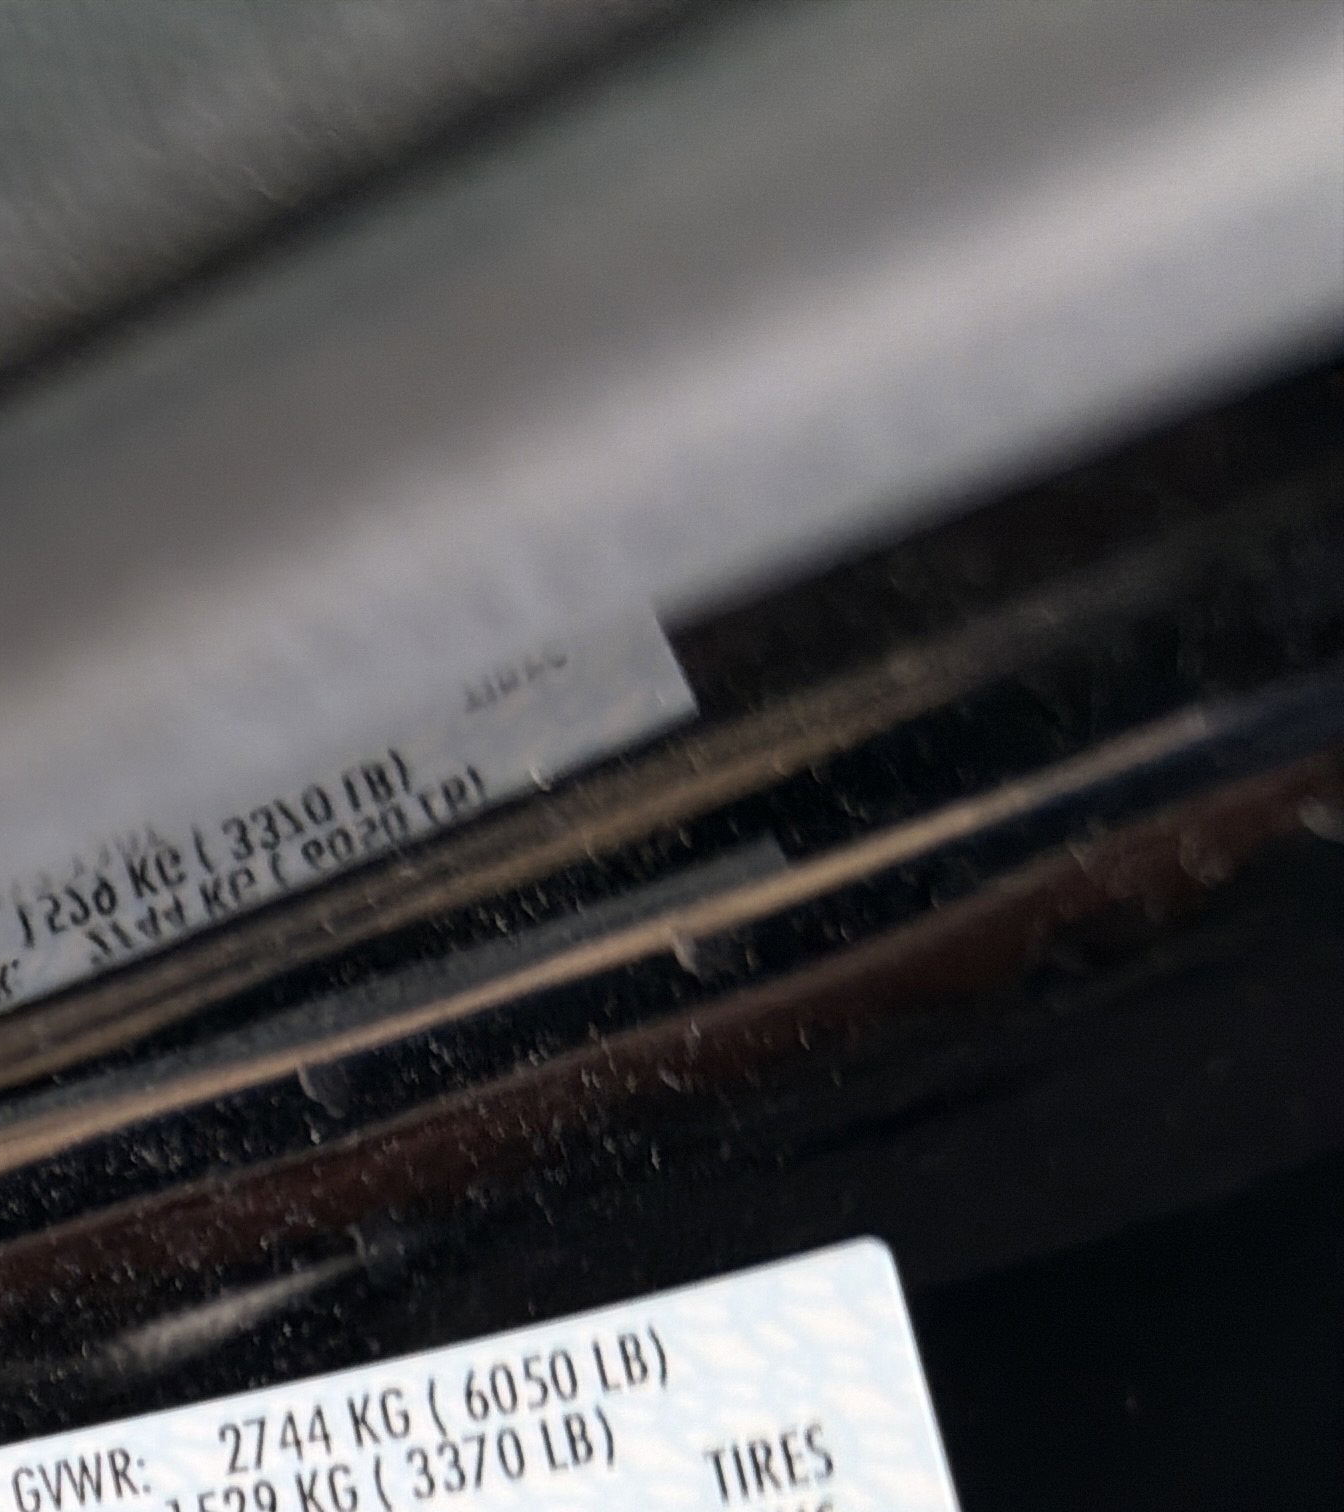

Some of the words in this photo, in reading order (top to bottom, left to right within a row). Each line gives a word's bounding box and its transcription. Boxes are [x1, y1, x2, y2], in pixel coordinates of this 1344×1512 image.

[217, 1403, 332, 1475] 2744
[346, 1387, 411, 1448] KG
[463, 1348, 579, 1421] 6050
[591, 1325, 668, 1392] LB)
[405, 1426, 526, 1500] 3370
[539, 1405, 615, 1470] LB)
[709, 1427, 834, 1501] TIRES
